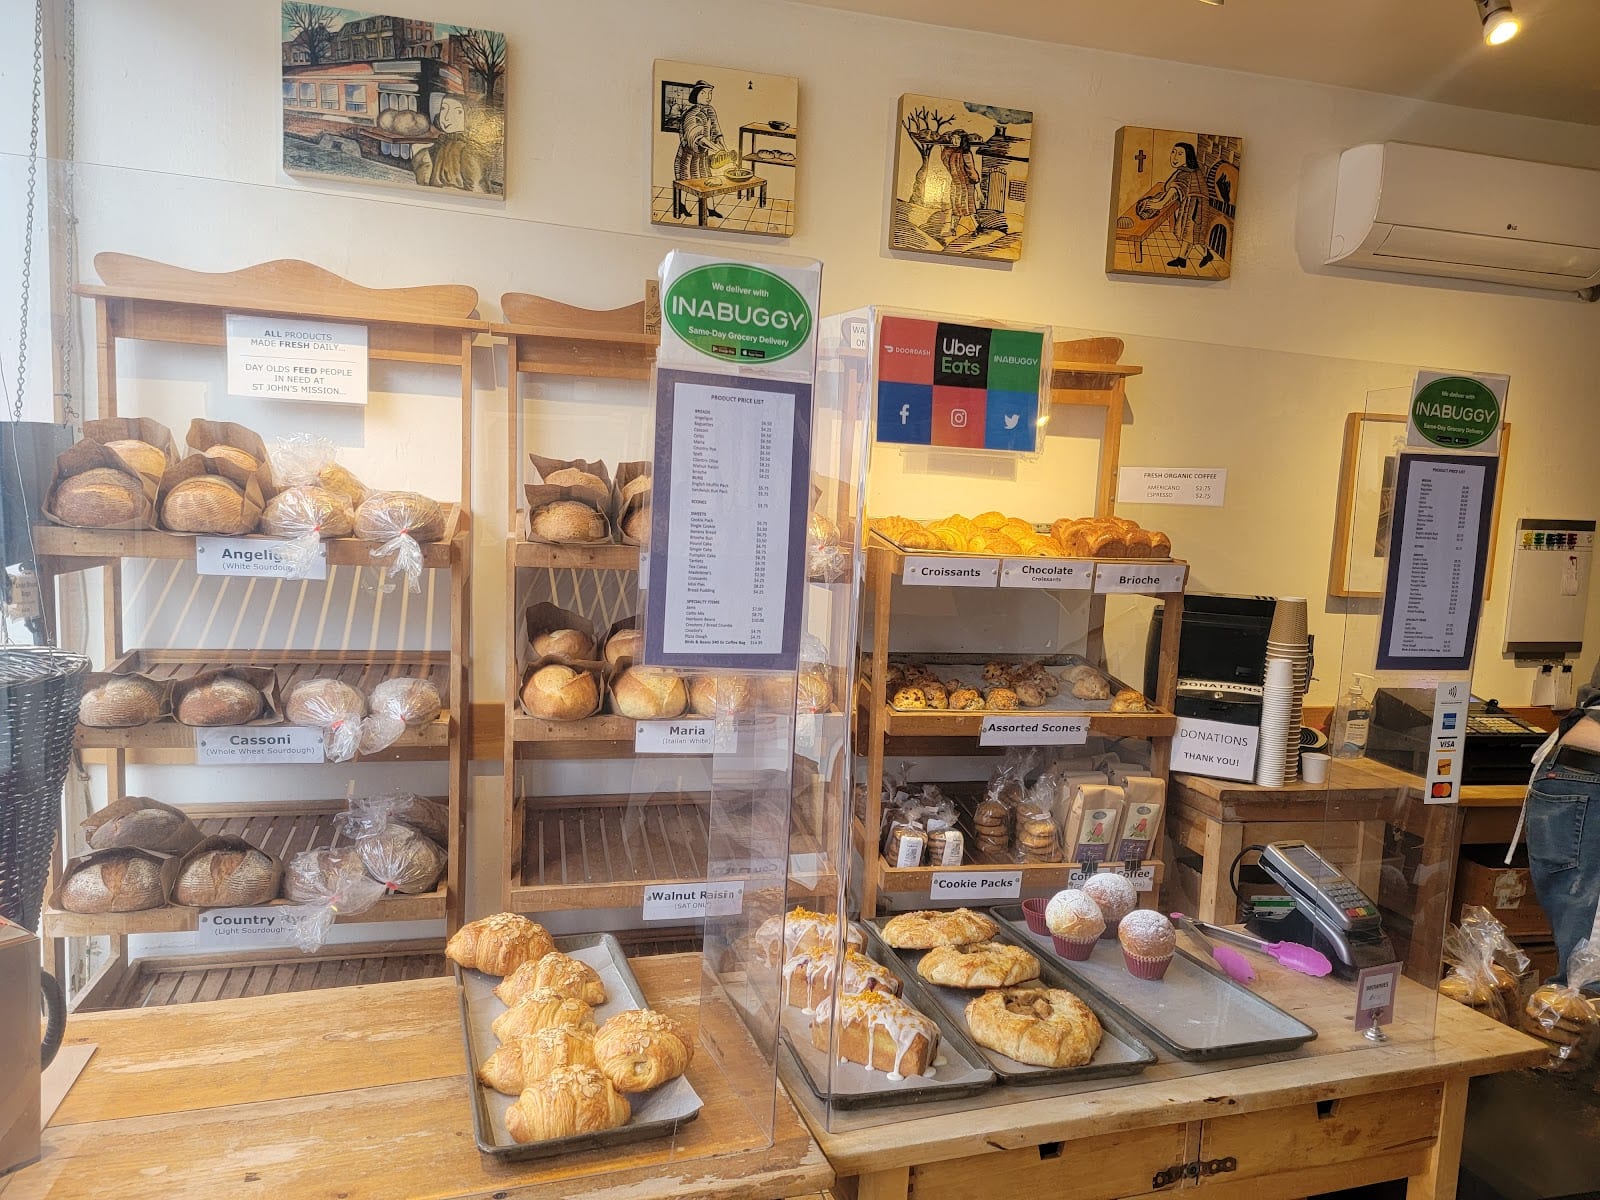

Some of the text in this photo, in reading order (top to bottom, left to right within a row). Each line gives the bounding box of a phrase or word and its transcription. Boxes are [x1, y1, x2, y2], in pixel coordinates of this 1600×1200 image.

[712, 282, 769, 297] We deliver with
[672, 296, 804, 331] INABUGGY
[285, 332, 332, 340] PRODUCTS
[689, 326, 789, 347] Same-Day Grocery Delivery
[251, 339, 277, 347] MADE
[280, 341, 310, 349] FRESH
[942, 338, 982, 358] Uber
[896, 346, 931, 356] DOORDASH
[994, 355, 1038, 366] INABUGGY
[320, 368, 352, 376] PEOPLE
[941, 357, 981, 376] Eats
[287, 376, 311, 384] NEED
[711, 394, 736, 402] PRODUCT
[1416, 401, 1495, 423] INABUGGY
[222, 562, 250, 570] (White
[1022, 565, 1073, 576] Chocolate
[922, 567, 981, 578] Croissants
[1119, 575, 1160, 585] Brioche
[1180, 682, 1261, 693] DONATIONS
[670, 726, 705, 735] Maria
[988, 724, 1081, 732] Assorted Scones
[230, 734, 291, 745] Cassoni
[1181, 729, 1248, 746] DONATIONS
[206, 748, 236, 756] (Whole
[267, 747, 315, 755] Sourdough)
[1184, 752, 1239, 766] THANK YOU!
[939, 879, 1013, 889] Cookie Packs
[652, 890, 734, 901] Walnut Raisin
[213, 915, 275, 926] Country
[215, 928, 239, 936] (Light
